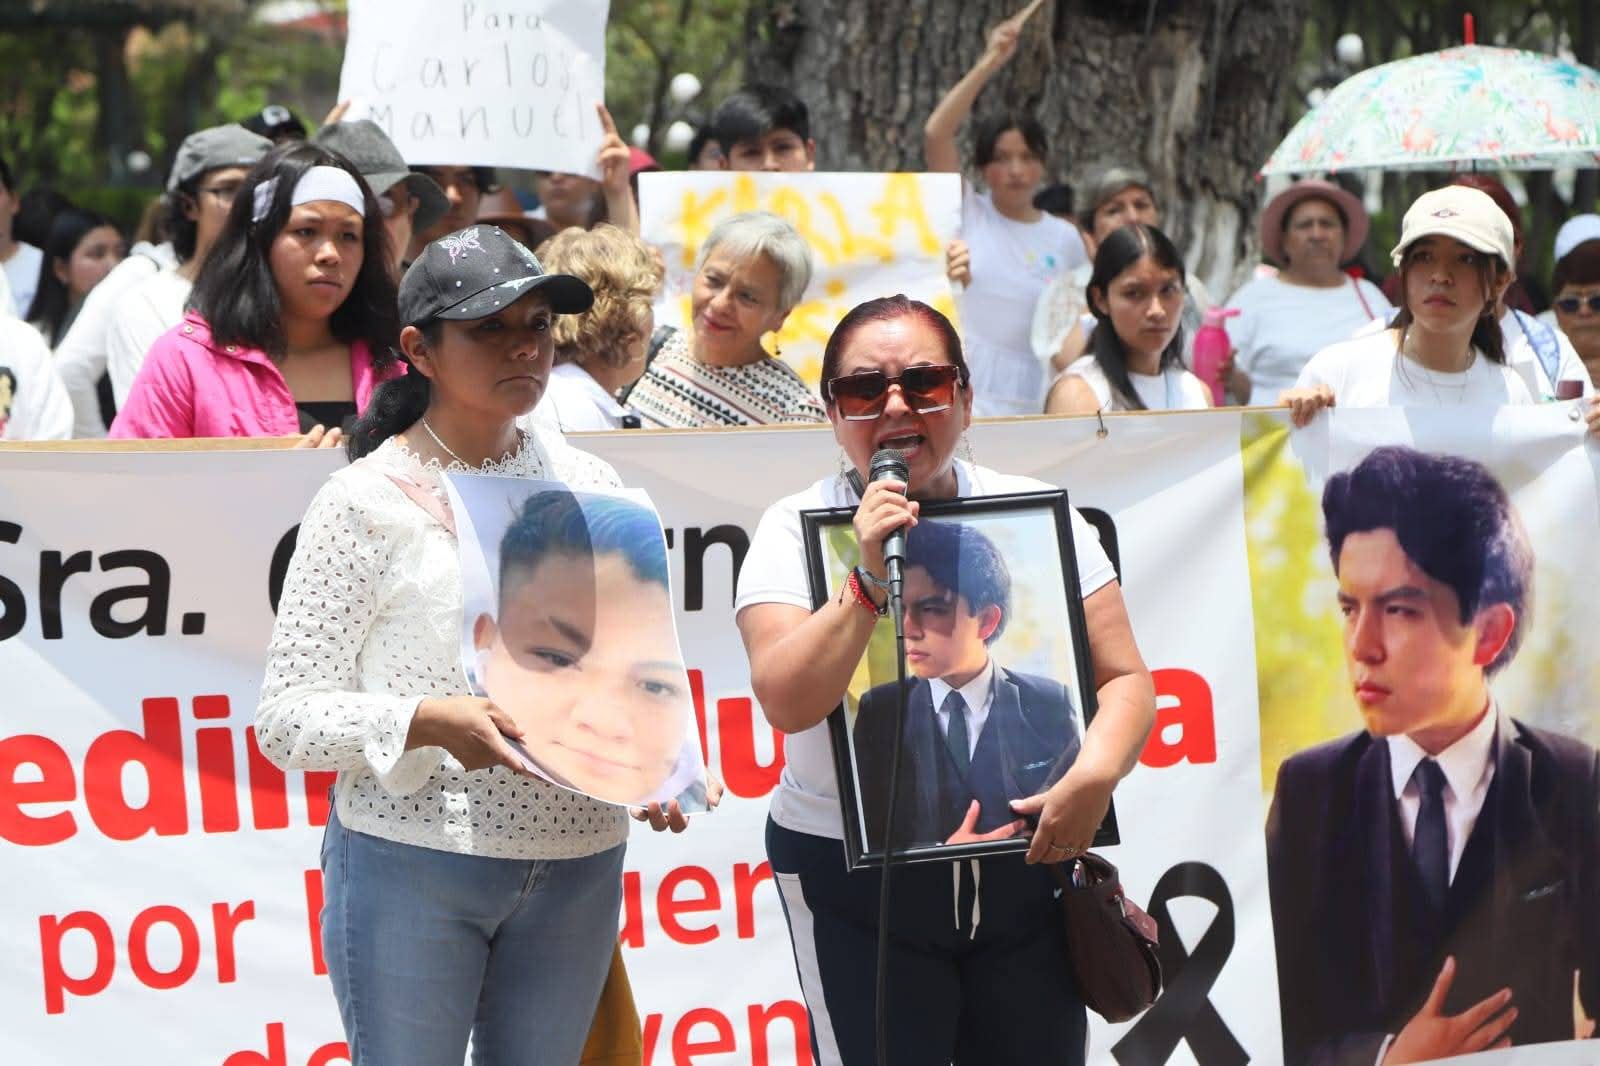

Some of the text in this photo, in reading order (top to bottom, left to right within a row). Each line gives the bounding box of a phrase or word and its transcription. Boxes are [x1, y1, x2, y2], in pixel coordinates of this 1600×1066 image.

[461, 0, 544, 32] Para
[371, 41, 570, 95] Carlos
[369, 92, 586, 141] Manuel
[0, 520, 206, 641] Sra.
[39, 900, 256, 1015] por
